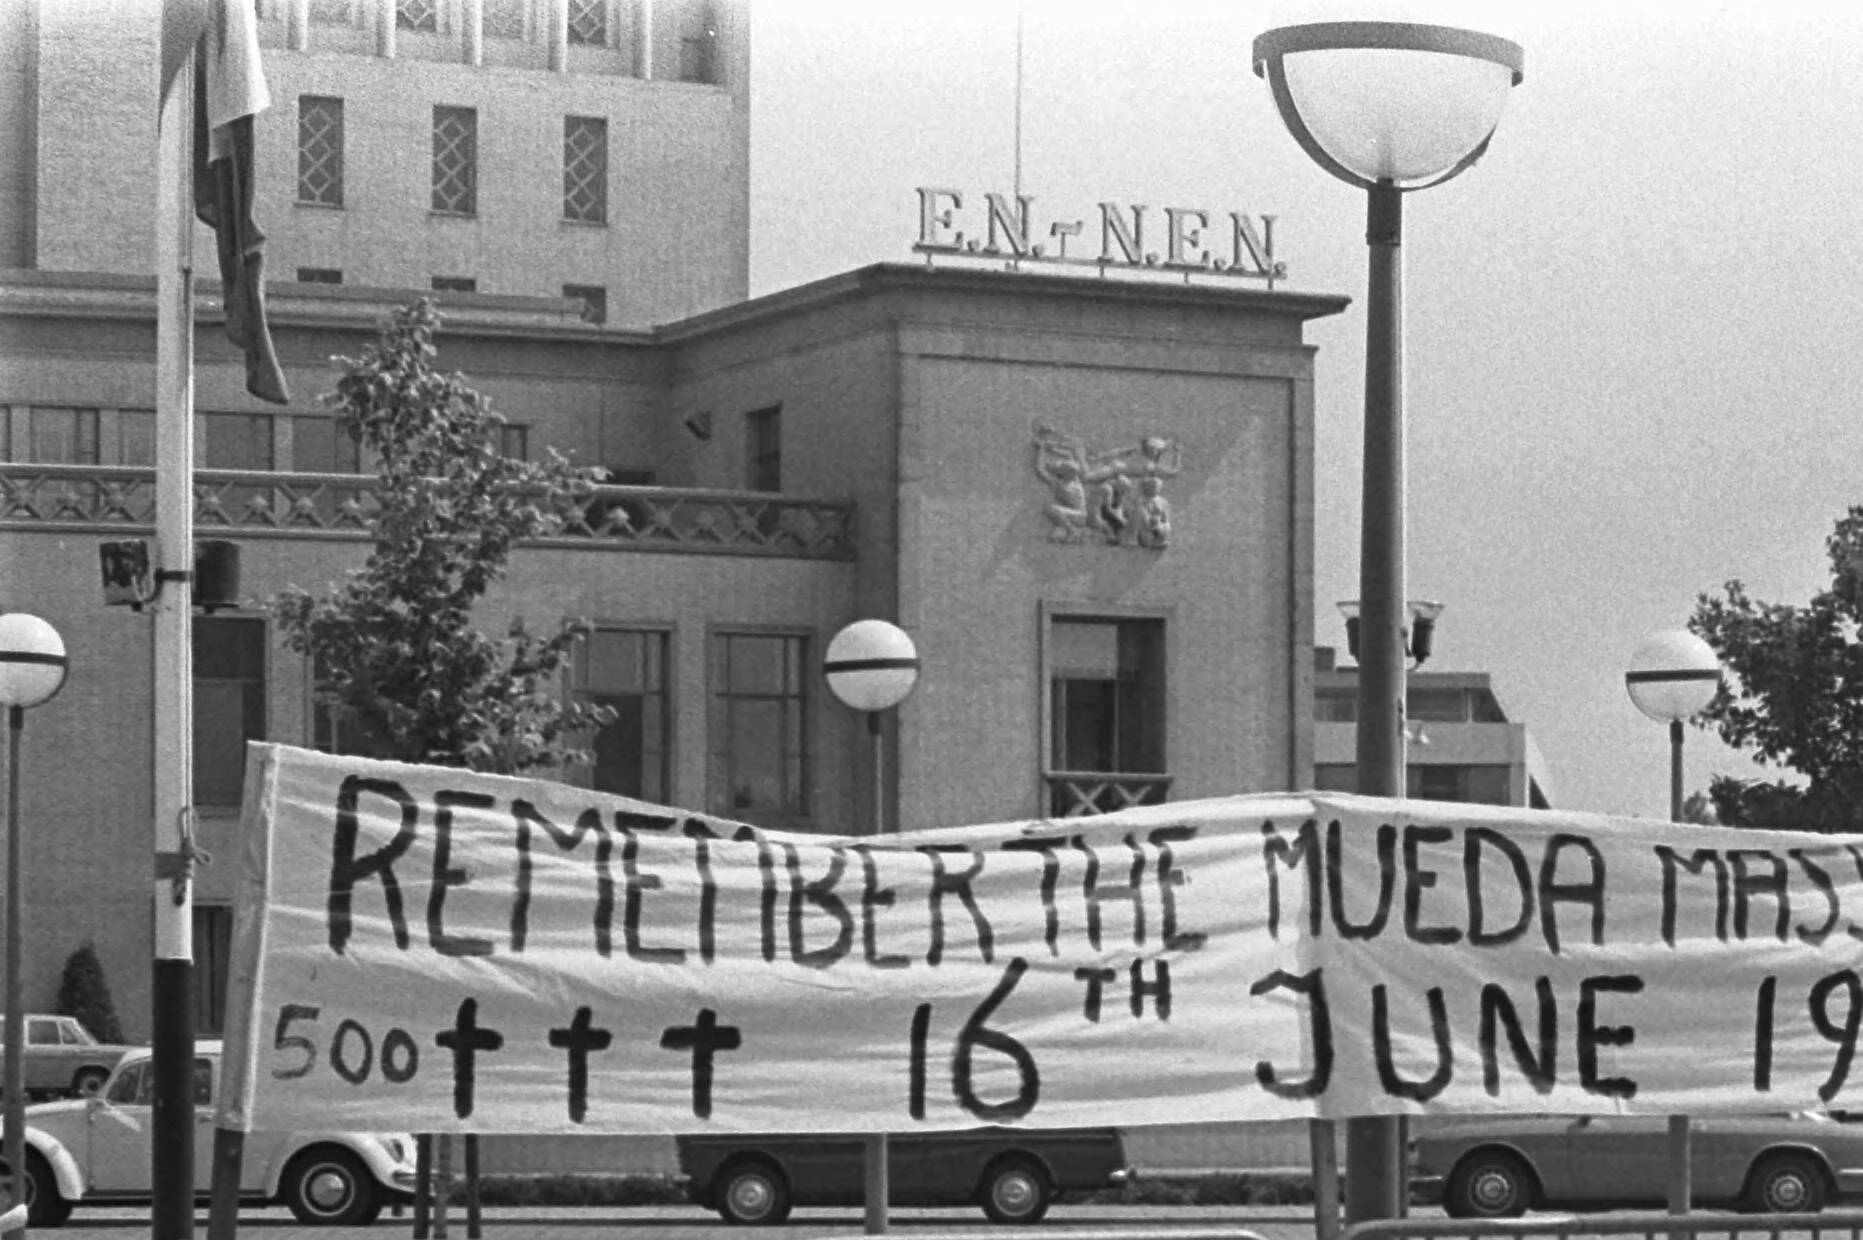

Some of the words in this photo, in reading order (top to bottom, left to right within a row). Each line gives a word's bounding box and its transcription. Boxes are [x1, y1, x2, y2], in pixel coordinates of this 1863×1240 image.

[328, 774, 993, 969] REMEMBER
[1002, 827, 1207, 956] THE
[1264, 820, 1605, 953] MUEDA
[272, 1004, 419, 1084] 500
[1250, 967, 1645, 1099] JUNE
